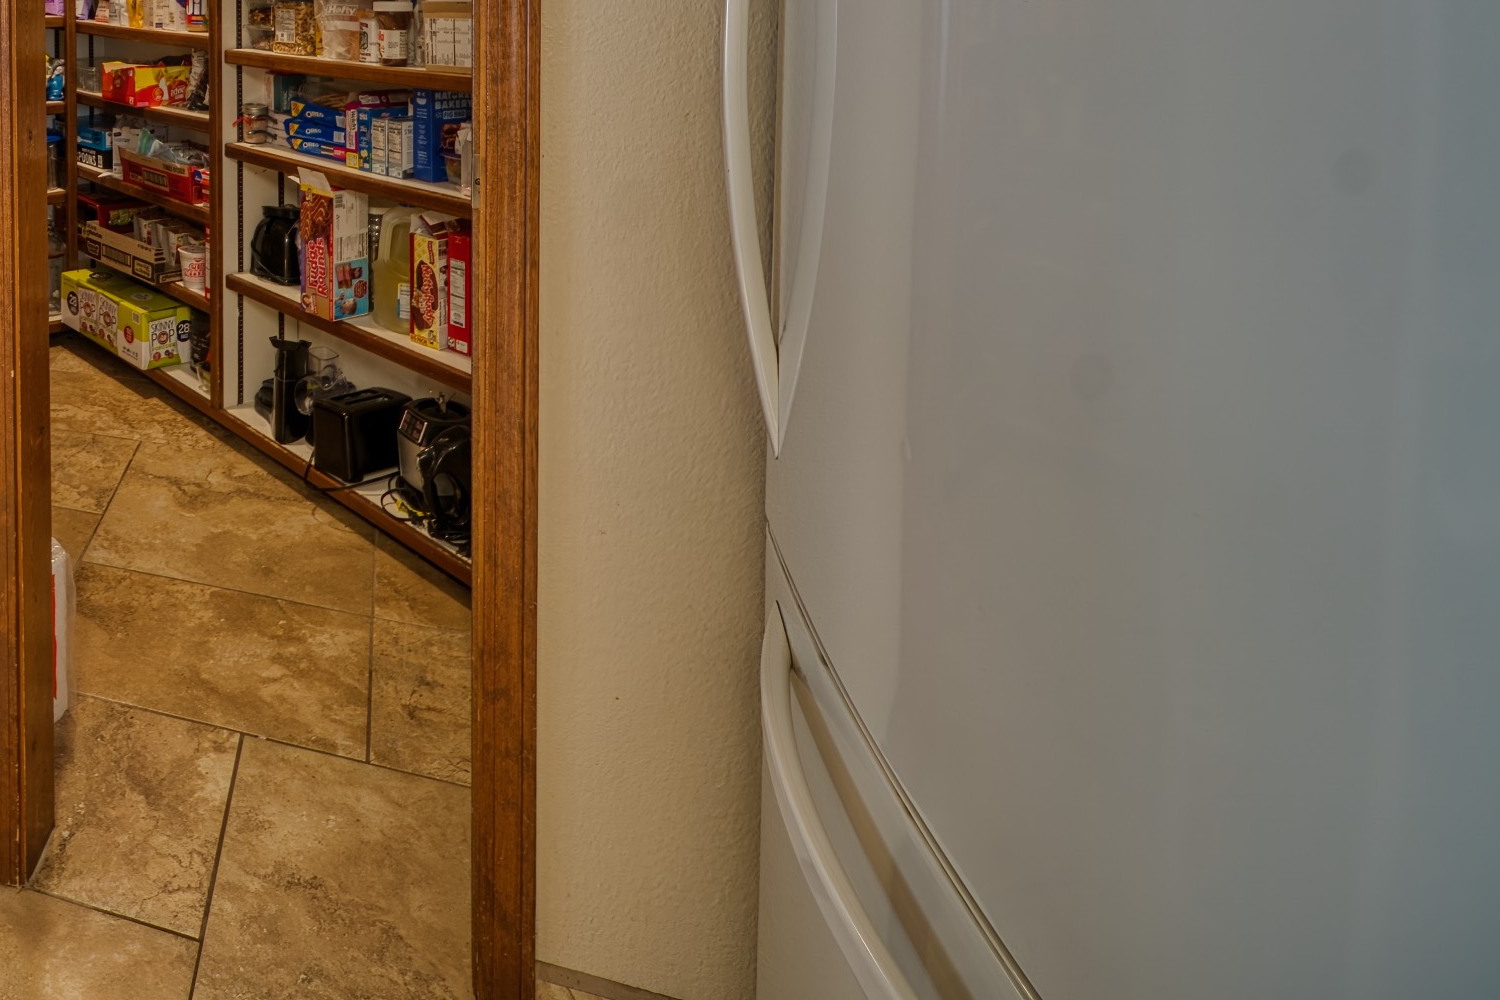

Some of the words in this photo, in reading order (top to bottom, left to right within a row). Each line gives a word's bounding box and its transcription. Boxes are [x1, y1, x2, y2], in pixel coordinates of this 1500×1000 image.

[327, 4, 357, 17] Hefty
[307, 239, 318, 289] Fudge
[316, 237, 328, 298] Rounds
[421, 264, 434, 292] Nutty
[423, 293, 436, 327] Buddy
[151, 319, 174, 332] SKINNY
[178, 323, 190, 334] 28
[151, 328, 175, 347] POP
